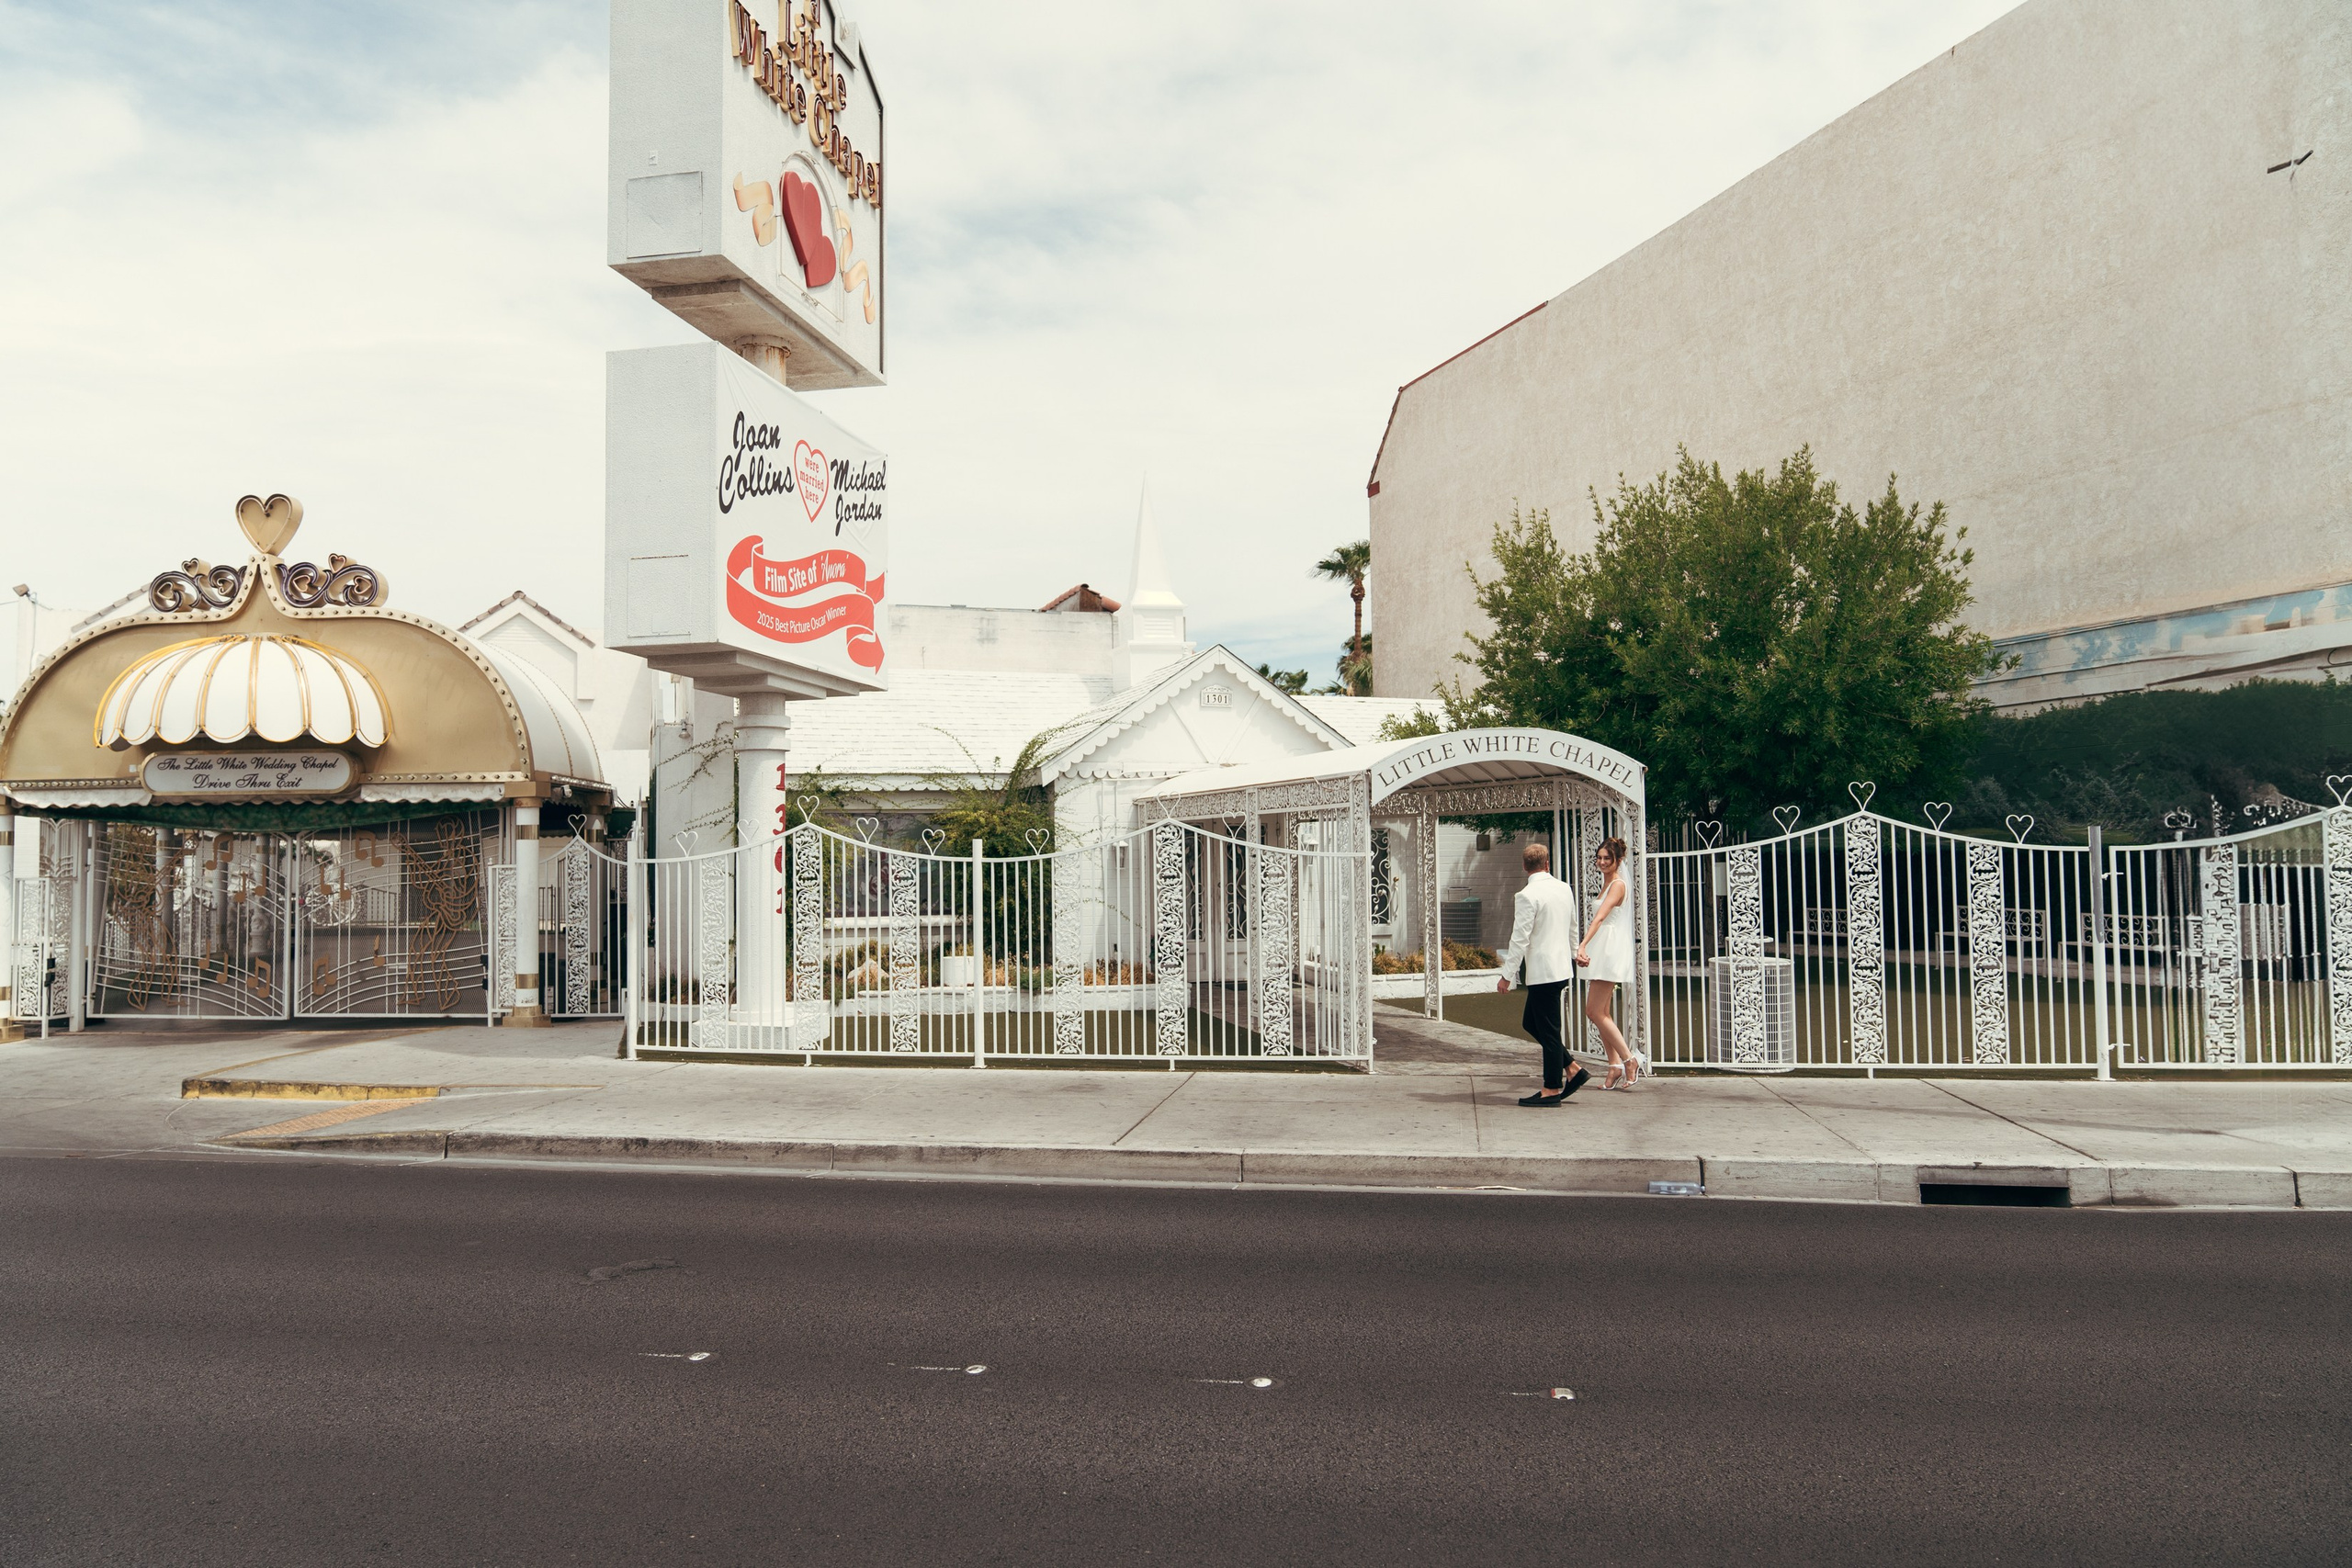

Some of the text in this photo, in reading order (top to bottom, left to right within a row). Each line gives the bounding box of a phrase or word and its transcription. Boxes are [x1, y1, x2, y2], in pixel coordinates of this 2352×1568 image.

[777, 0, 847, 112] Little
[729, 0, 881, 209] White Chapel
[733, 411, 781, 472] Joan
[799, 470, 824, 492] married
[805, 457, 820, 474] were
[831, 458, 887, 493] Michael
[718, 455, 795, 514] Collins
[805, 485, 820, 504] here
[835, 492, 883, 536] Jordan
[764, 565, 787, 593] Film
[787, 566, 808, 592] Site
[808, 558, 818, 585] of
[756, 605, 847, 634] 2025 Best Picture Oscar Winner
[1206, 694, 1227, 704] 1301
[157, 756, 337, 773] The Little White Wedding Chapel
[1377, 735, 1634, 789] LITTLE WHITE CHAPEL
[192, 773, 302, 789] Drive Thru Exit
